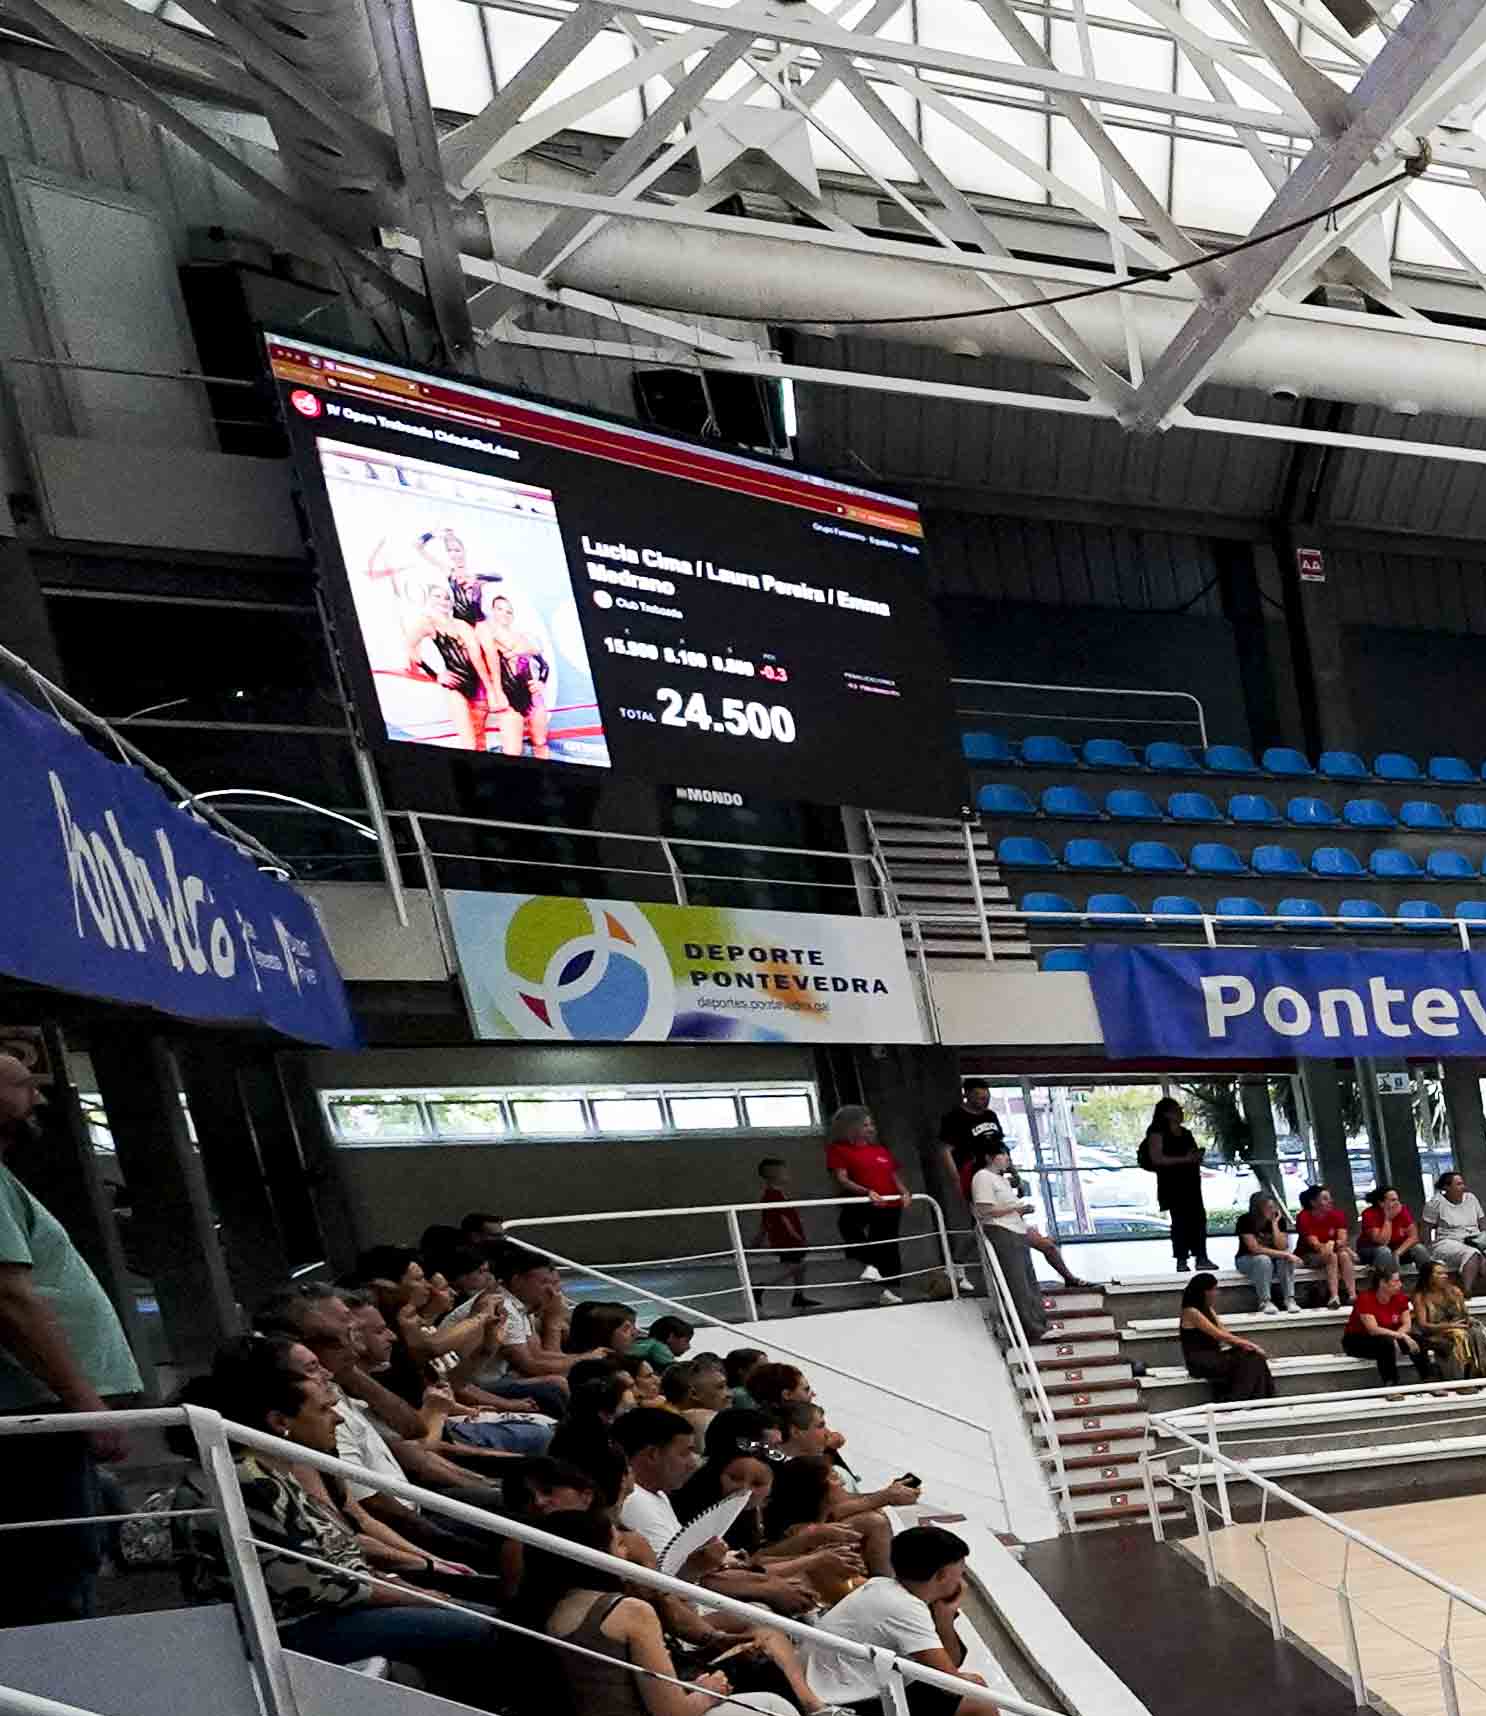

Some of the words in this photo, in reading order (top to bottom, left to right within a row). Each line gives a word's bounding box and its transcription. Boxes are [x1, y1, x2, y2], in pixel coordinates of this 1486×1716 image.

[586, 561, 676, 596] Medrano
[705, 562, 760, 590] Laura
[836, 589, 891, 617] Emma
[759, 664, 788, 683] -0.3
[618, 706, 657, 723] TOTAL
[656, 687, 796, 743] 24.500
[687, 787, 744, 807] MONDO
[683, 943, 825, 966] DEPORTE
[689, 970, 889, 995] PONTEVEDRA
